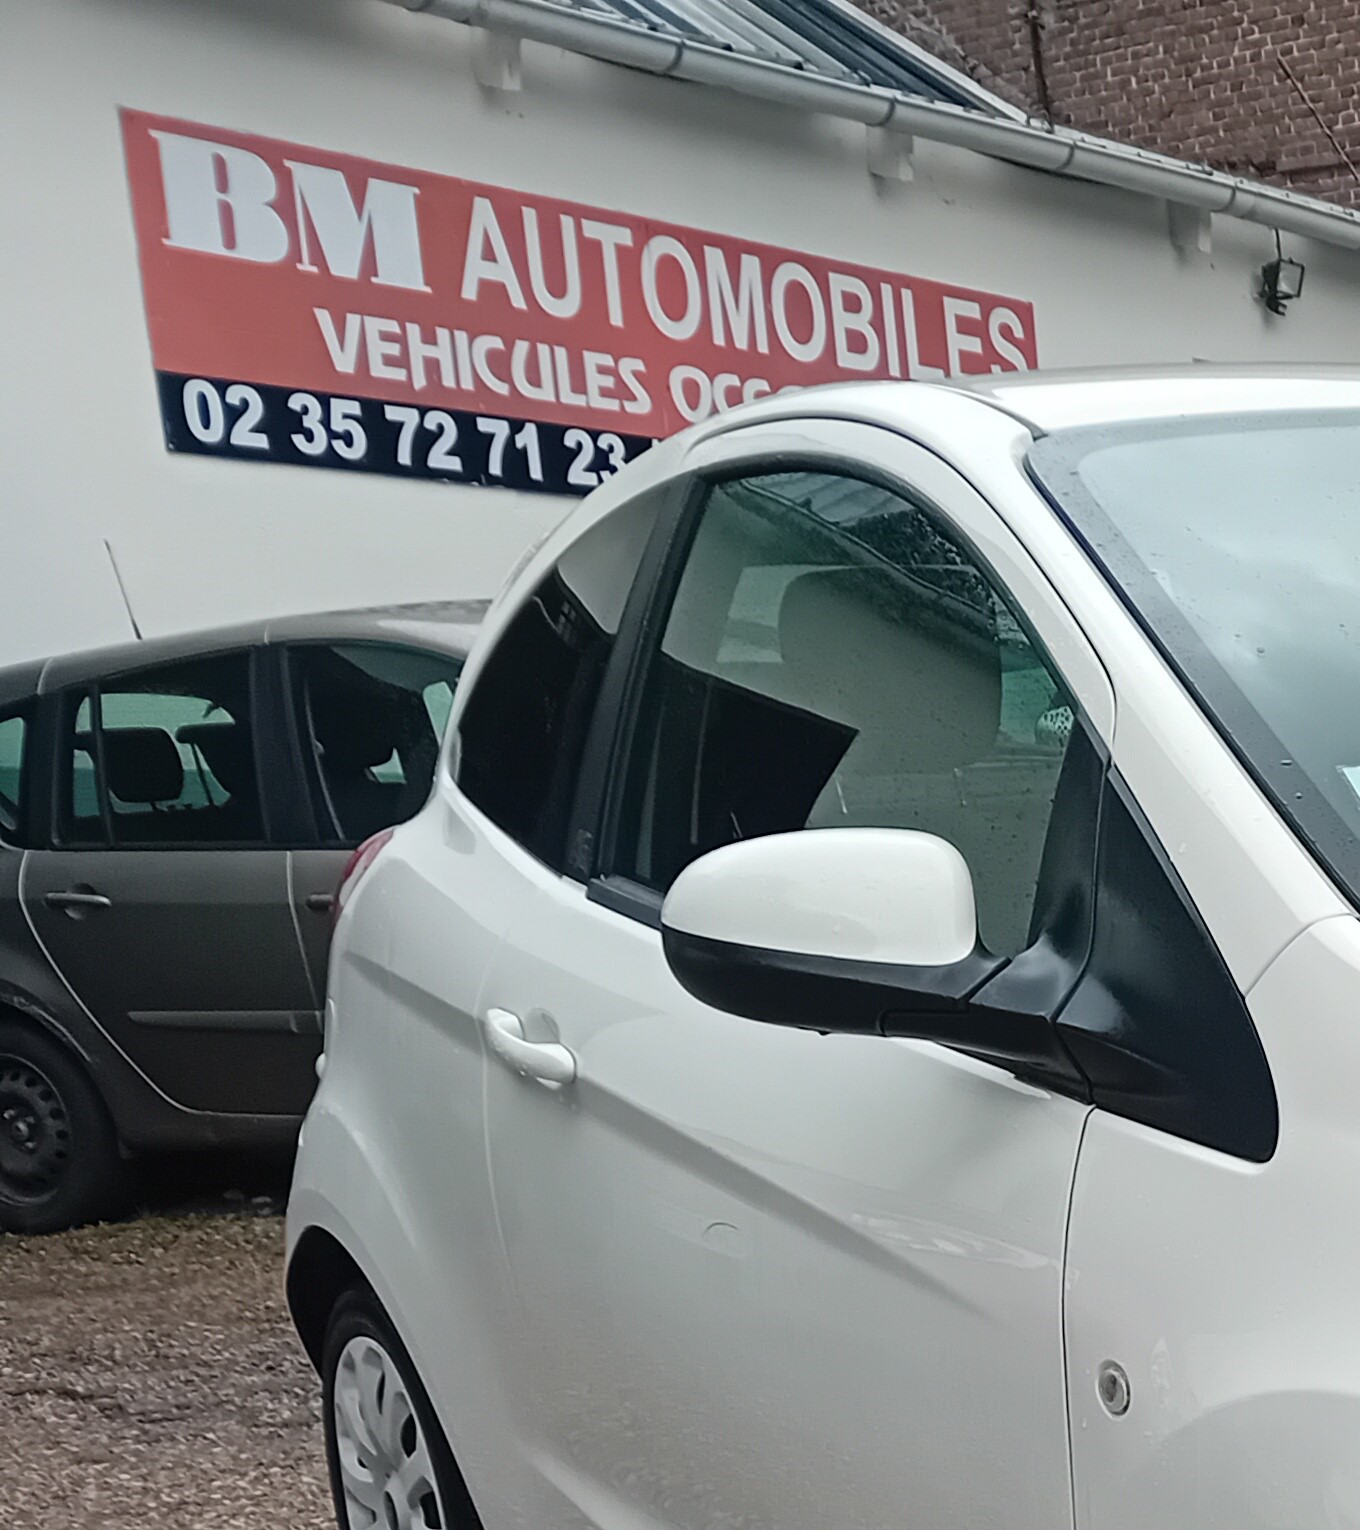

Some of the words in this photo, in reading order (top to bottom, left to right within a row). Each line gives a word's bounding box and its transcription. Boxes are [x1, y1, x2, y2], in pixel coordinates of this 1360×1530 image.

[148, 129, 432, 293] BM
[461, 195, 1028, 380] AUTOMOBILES
[313, 306, 652, 414] VEHICULES
[182, 378, 270, 452] 02
[287, 391, 368, 462] 35
[395, 404, 464, 474] 72
[477, 413, 543, 480] 71
[563, 427, 626, 486] 23
